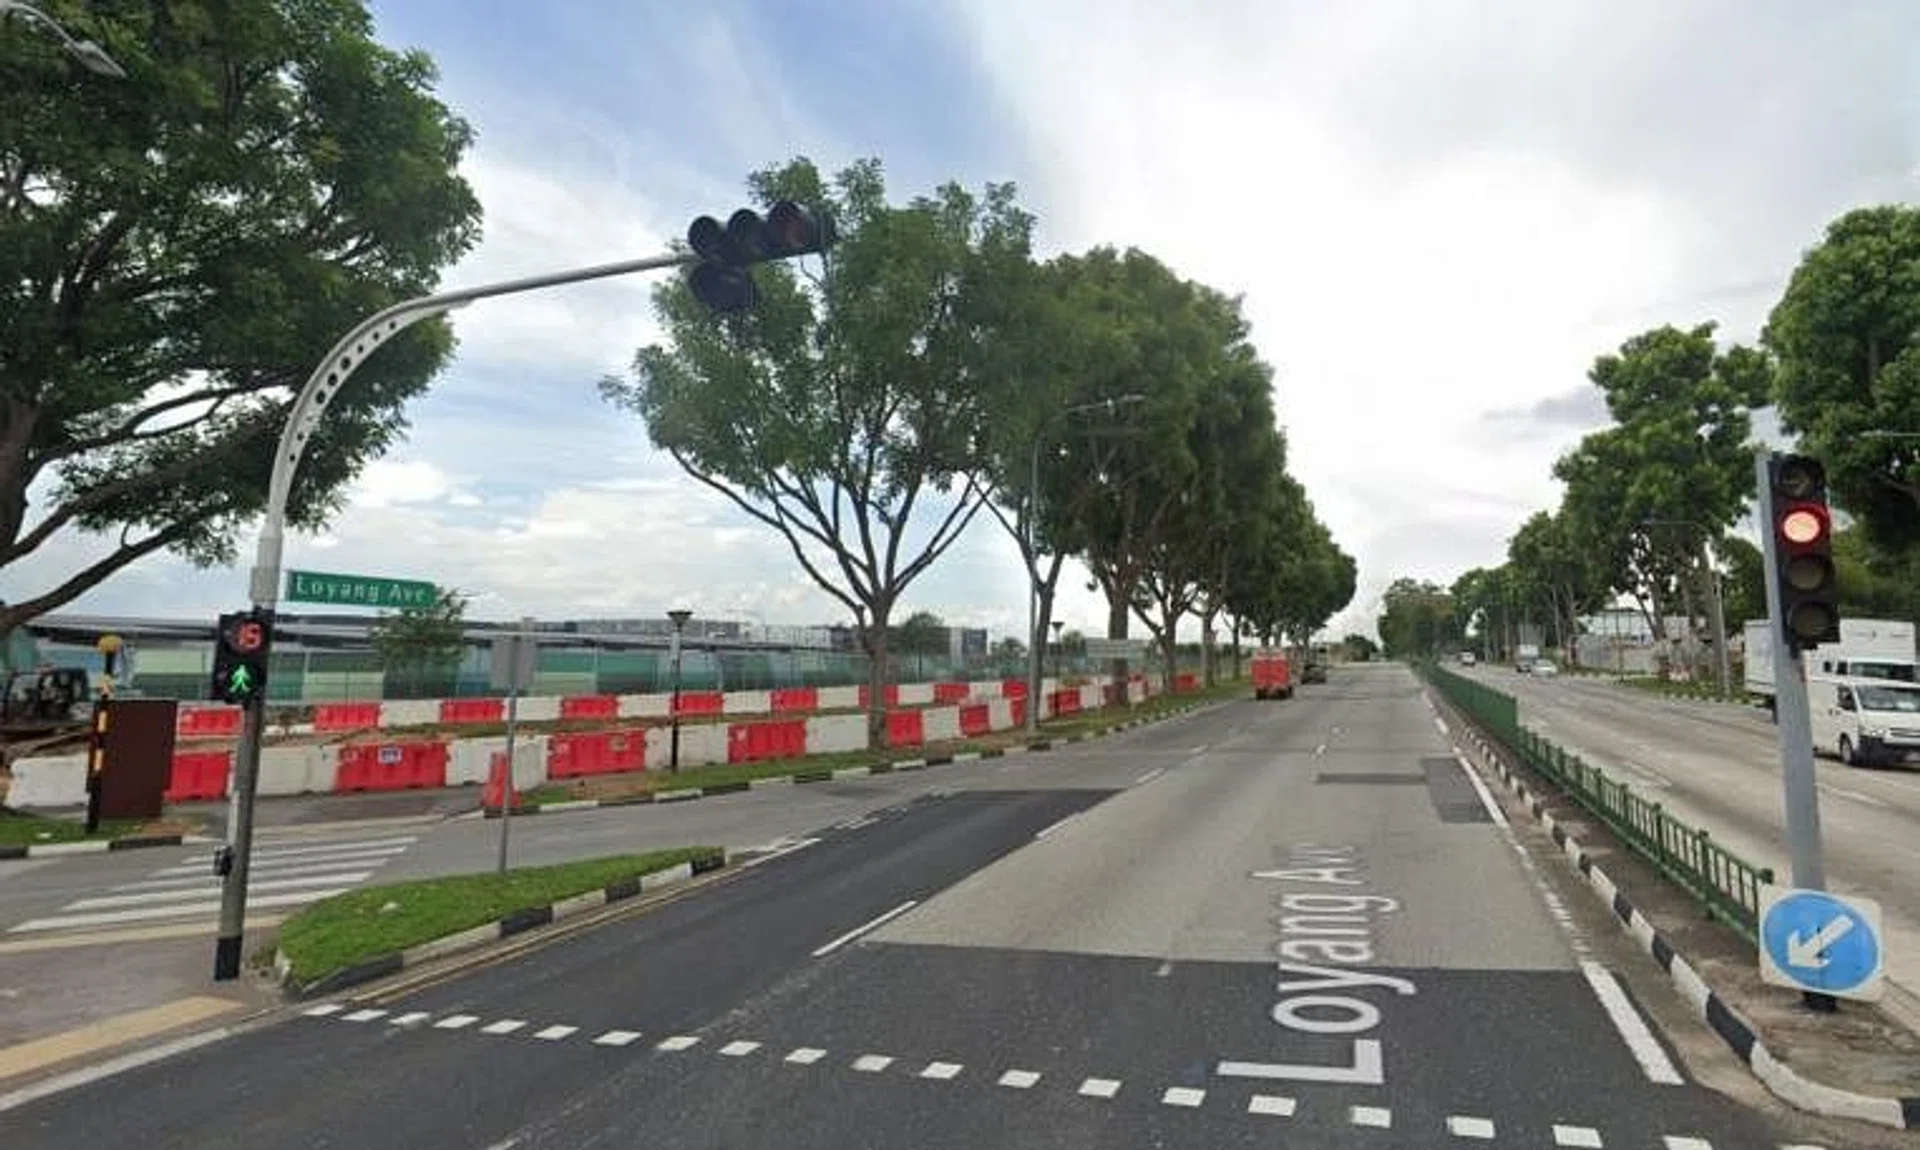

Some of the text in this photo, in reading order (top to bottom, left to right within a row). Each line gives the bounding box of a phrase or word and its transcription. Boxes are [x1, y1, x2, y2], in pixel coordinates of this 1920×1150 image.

[296, 574, 426, 603] Loyang Ave
[1217, 894, 1416, 1084] Loyang
